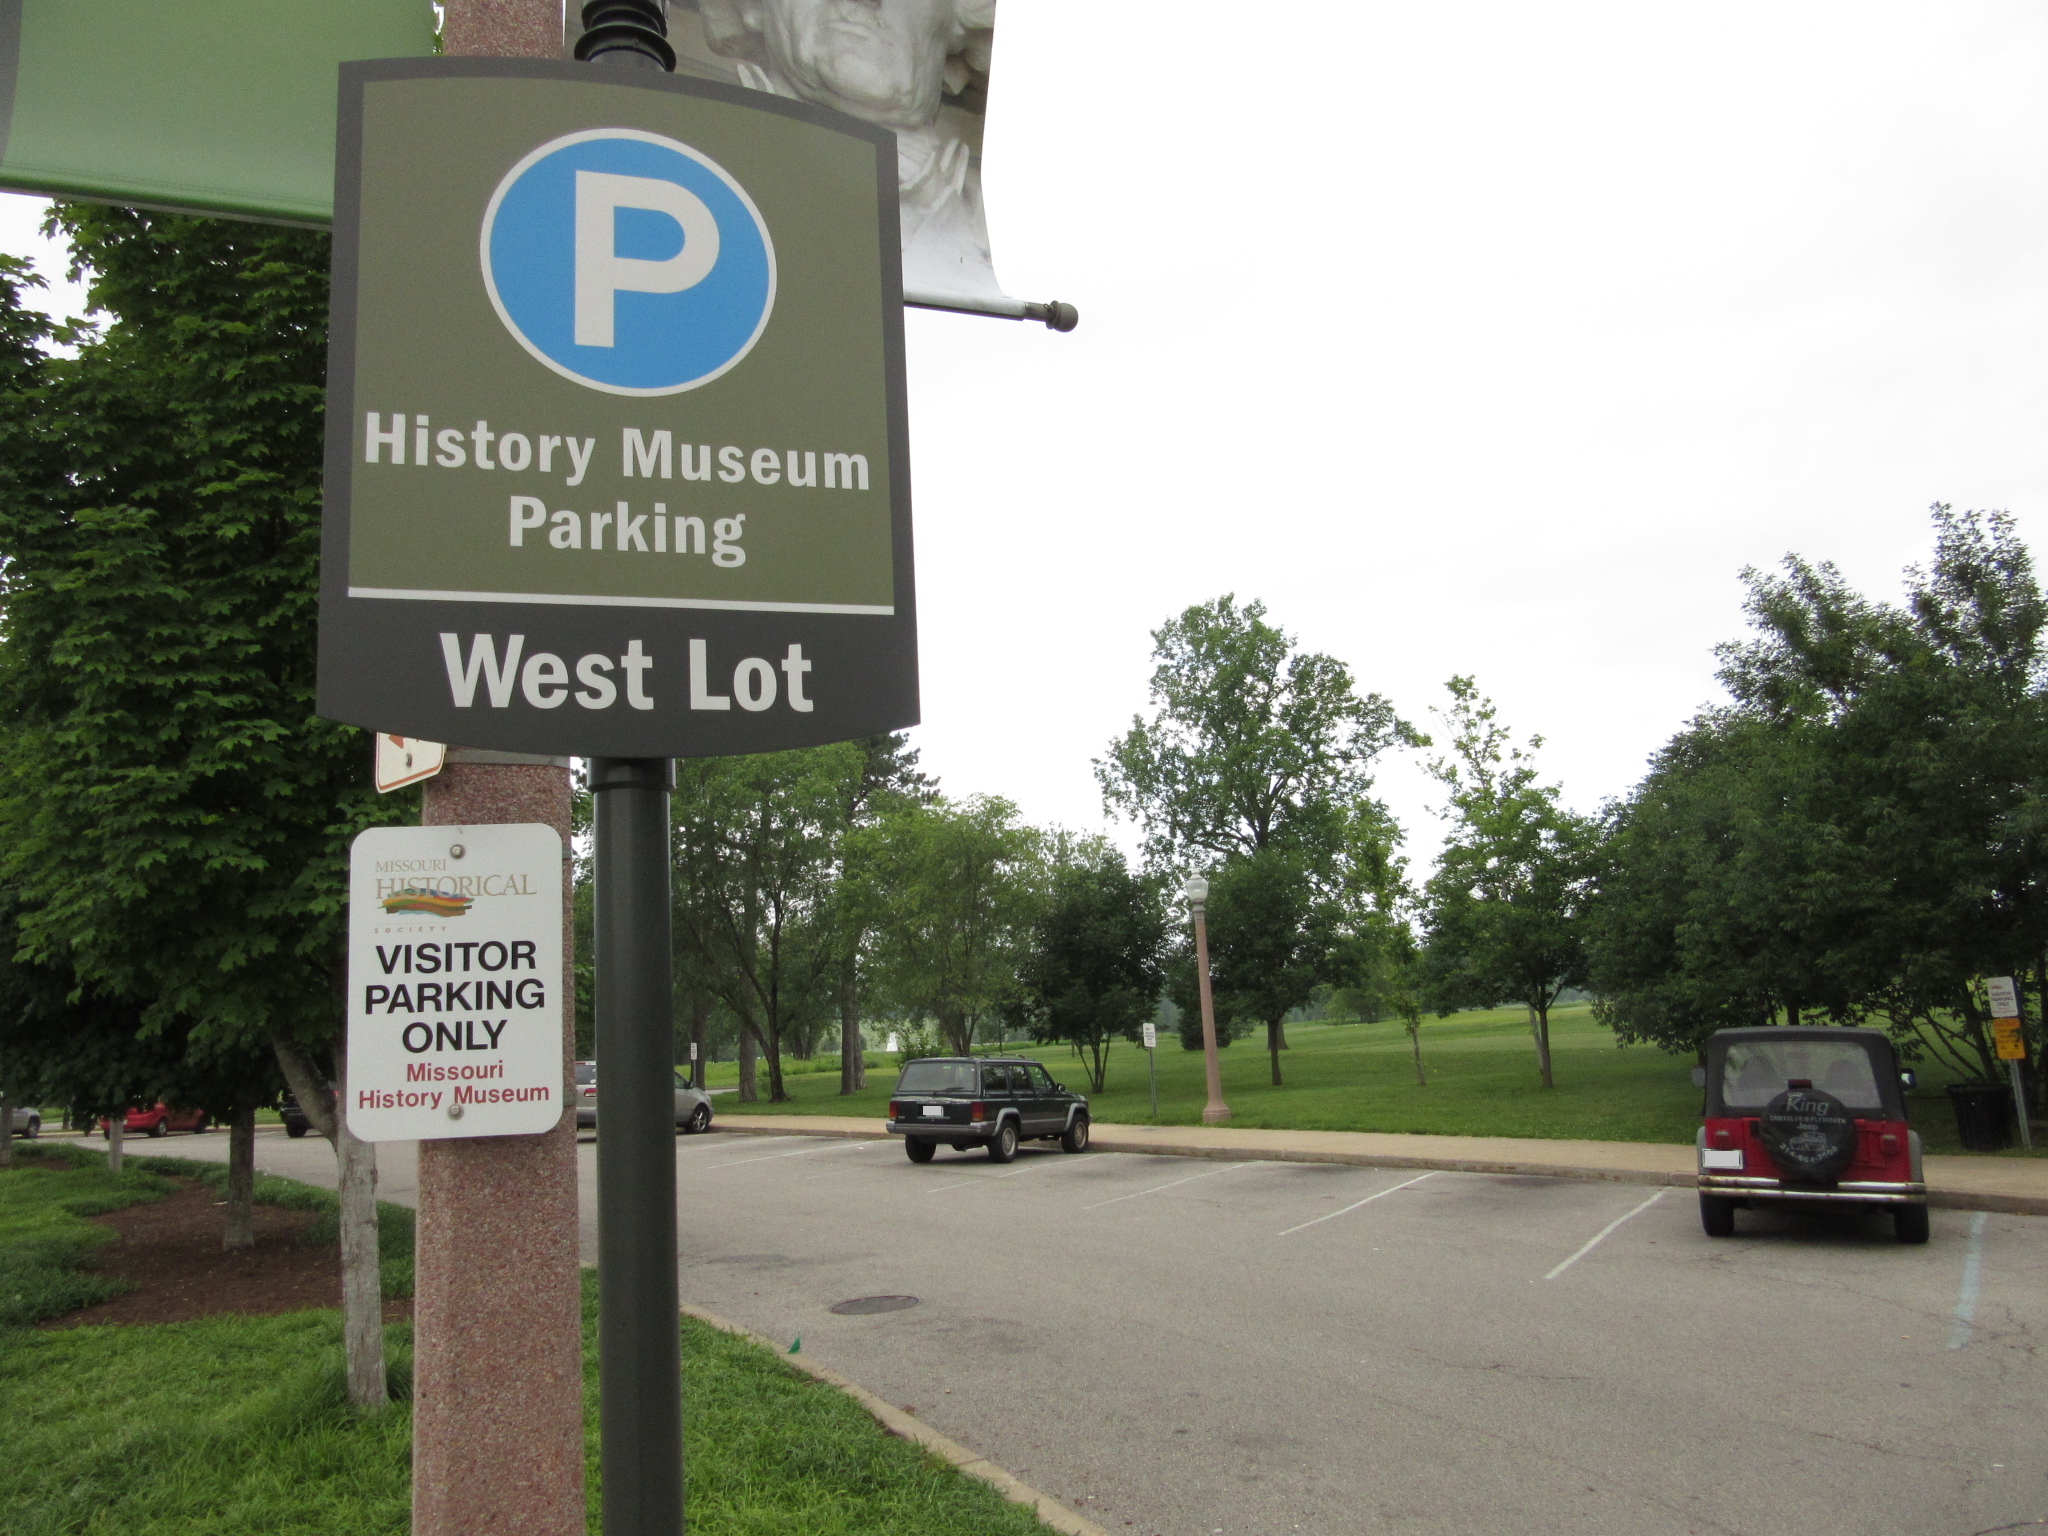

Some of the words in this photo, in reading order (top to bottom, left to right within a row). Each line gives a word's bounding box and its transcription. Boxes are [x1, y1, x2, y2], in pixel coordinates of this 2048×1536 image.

[574, 170, 720, 348] P
[365, 411, 596, 486] History
[622, 428, 870, 491] Museum
[509, 495, 747, 568] Parking
[439, 632, 655, 711] West
[689, 638, 814, 713] Lot
[375, 858, 448, 873] MISSOURI
[375, 874, 538, 900] HISTORICAL
[374, 925, 447, 934] SOCIETY
[375, 940, 537, 975] VISITOR
[365, 978, 546, 1015] PARKING
[402, 1019, 508, 1053] ONLY
[406, 1060, 504, 1083] Missouri
[359, 1090, 443, 1110] History
[453, 1085, 550, 1105] Museum
[1786, 1097, 1829, 1116] King
